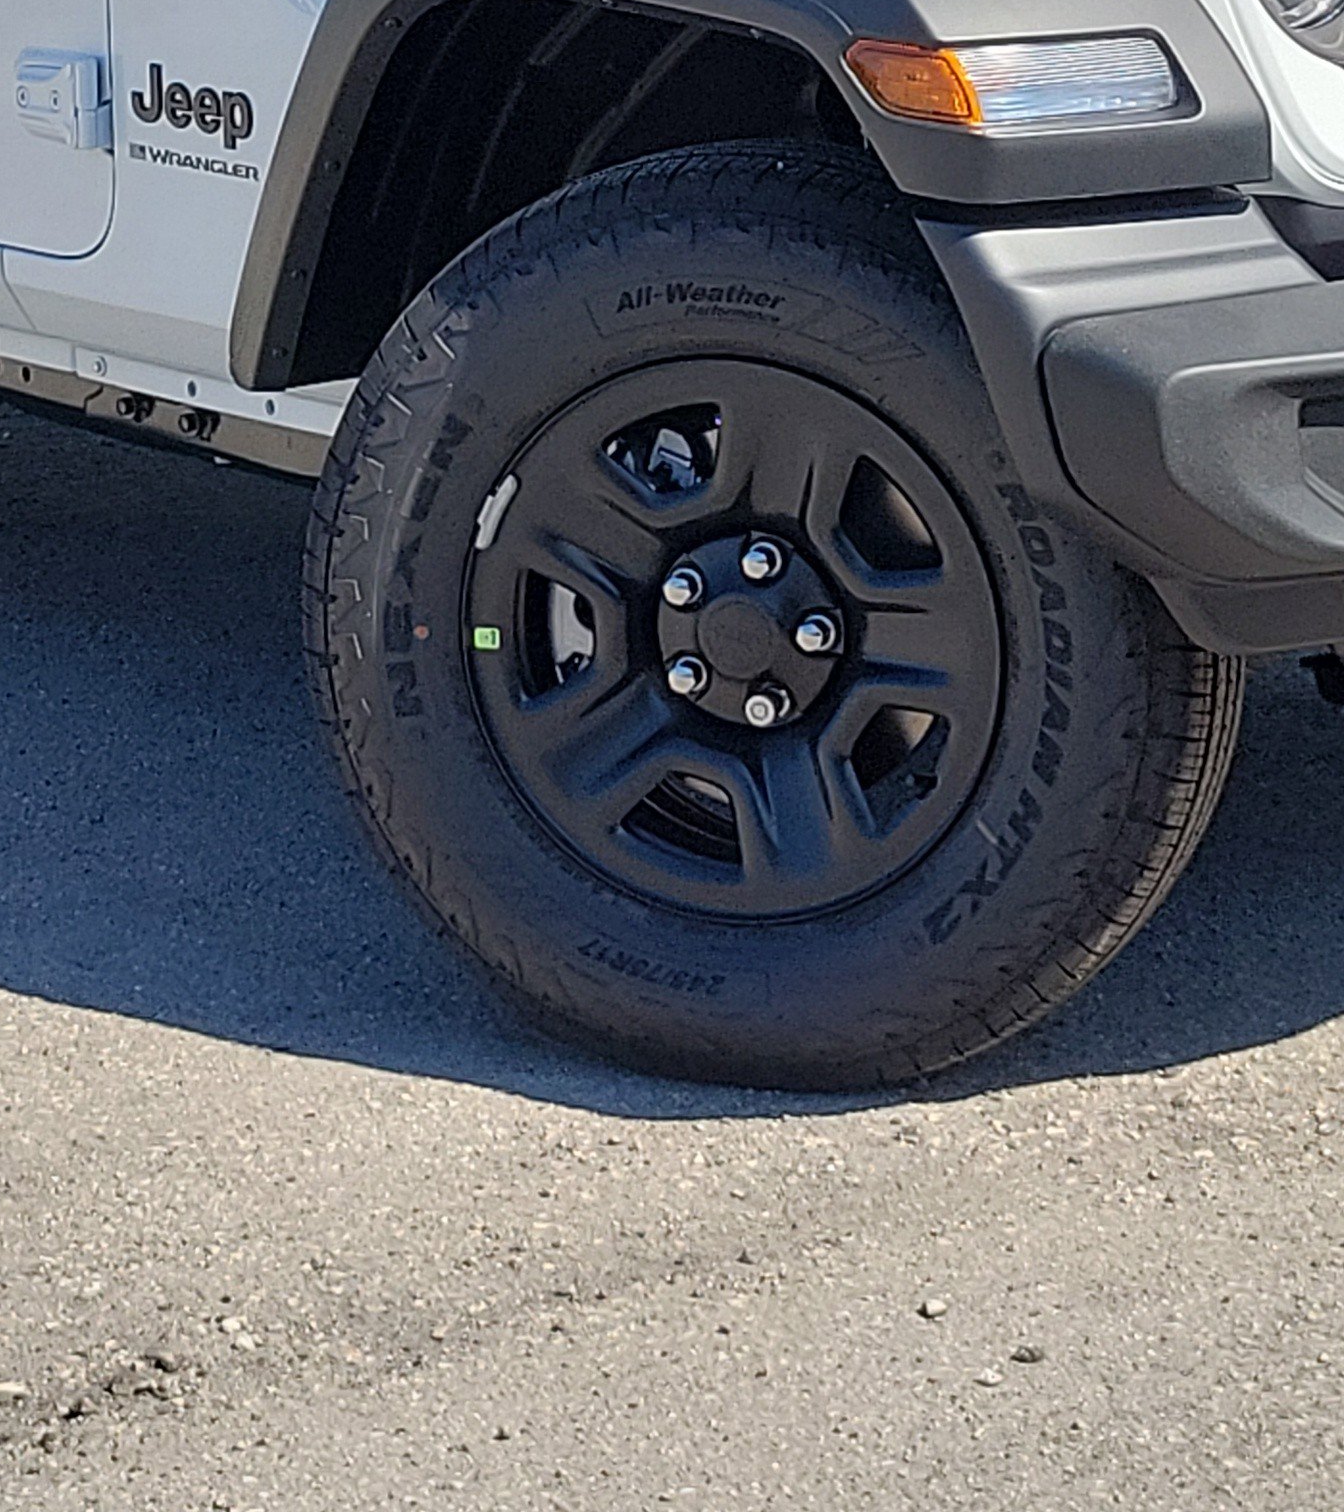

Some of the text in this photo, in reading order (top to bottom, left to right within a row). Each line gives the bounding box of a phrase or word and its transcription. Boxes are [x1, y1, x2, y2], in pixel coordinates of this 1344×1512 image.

[131, 62, 255, 151] Jeep
[147, 145, 261, 182] WRANGLER
[615, 280, 787, 314] All-Weather
[384, 412, 473, 718] NEXEN
[922, 482, 1075, 945] ROADIAN HTX2
